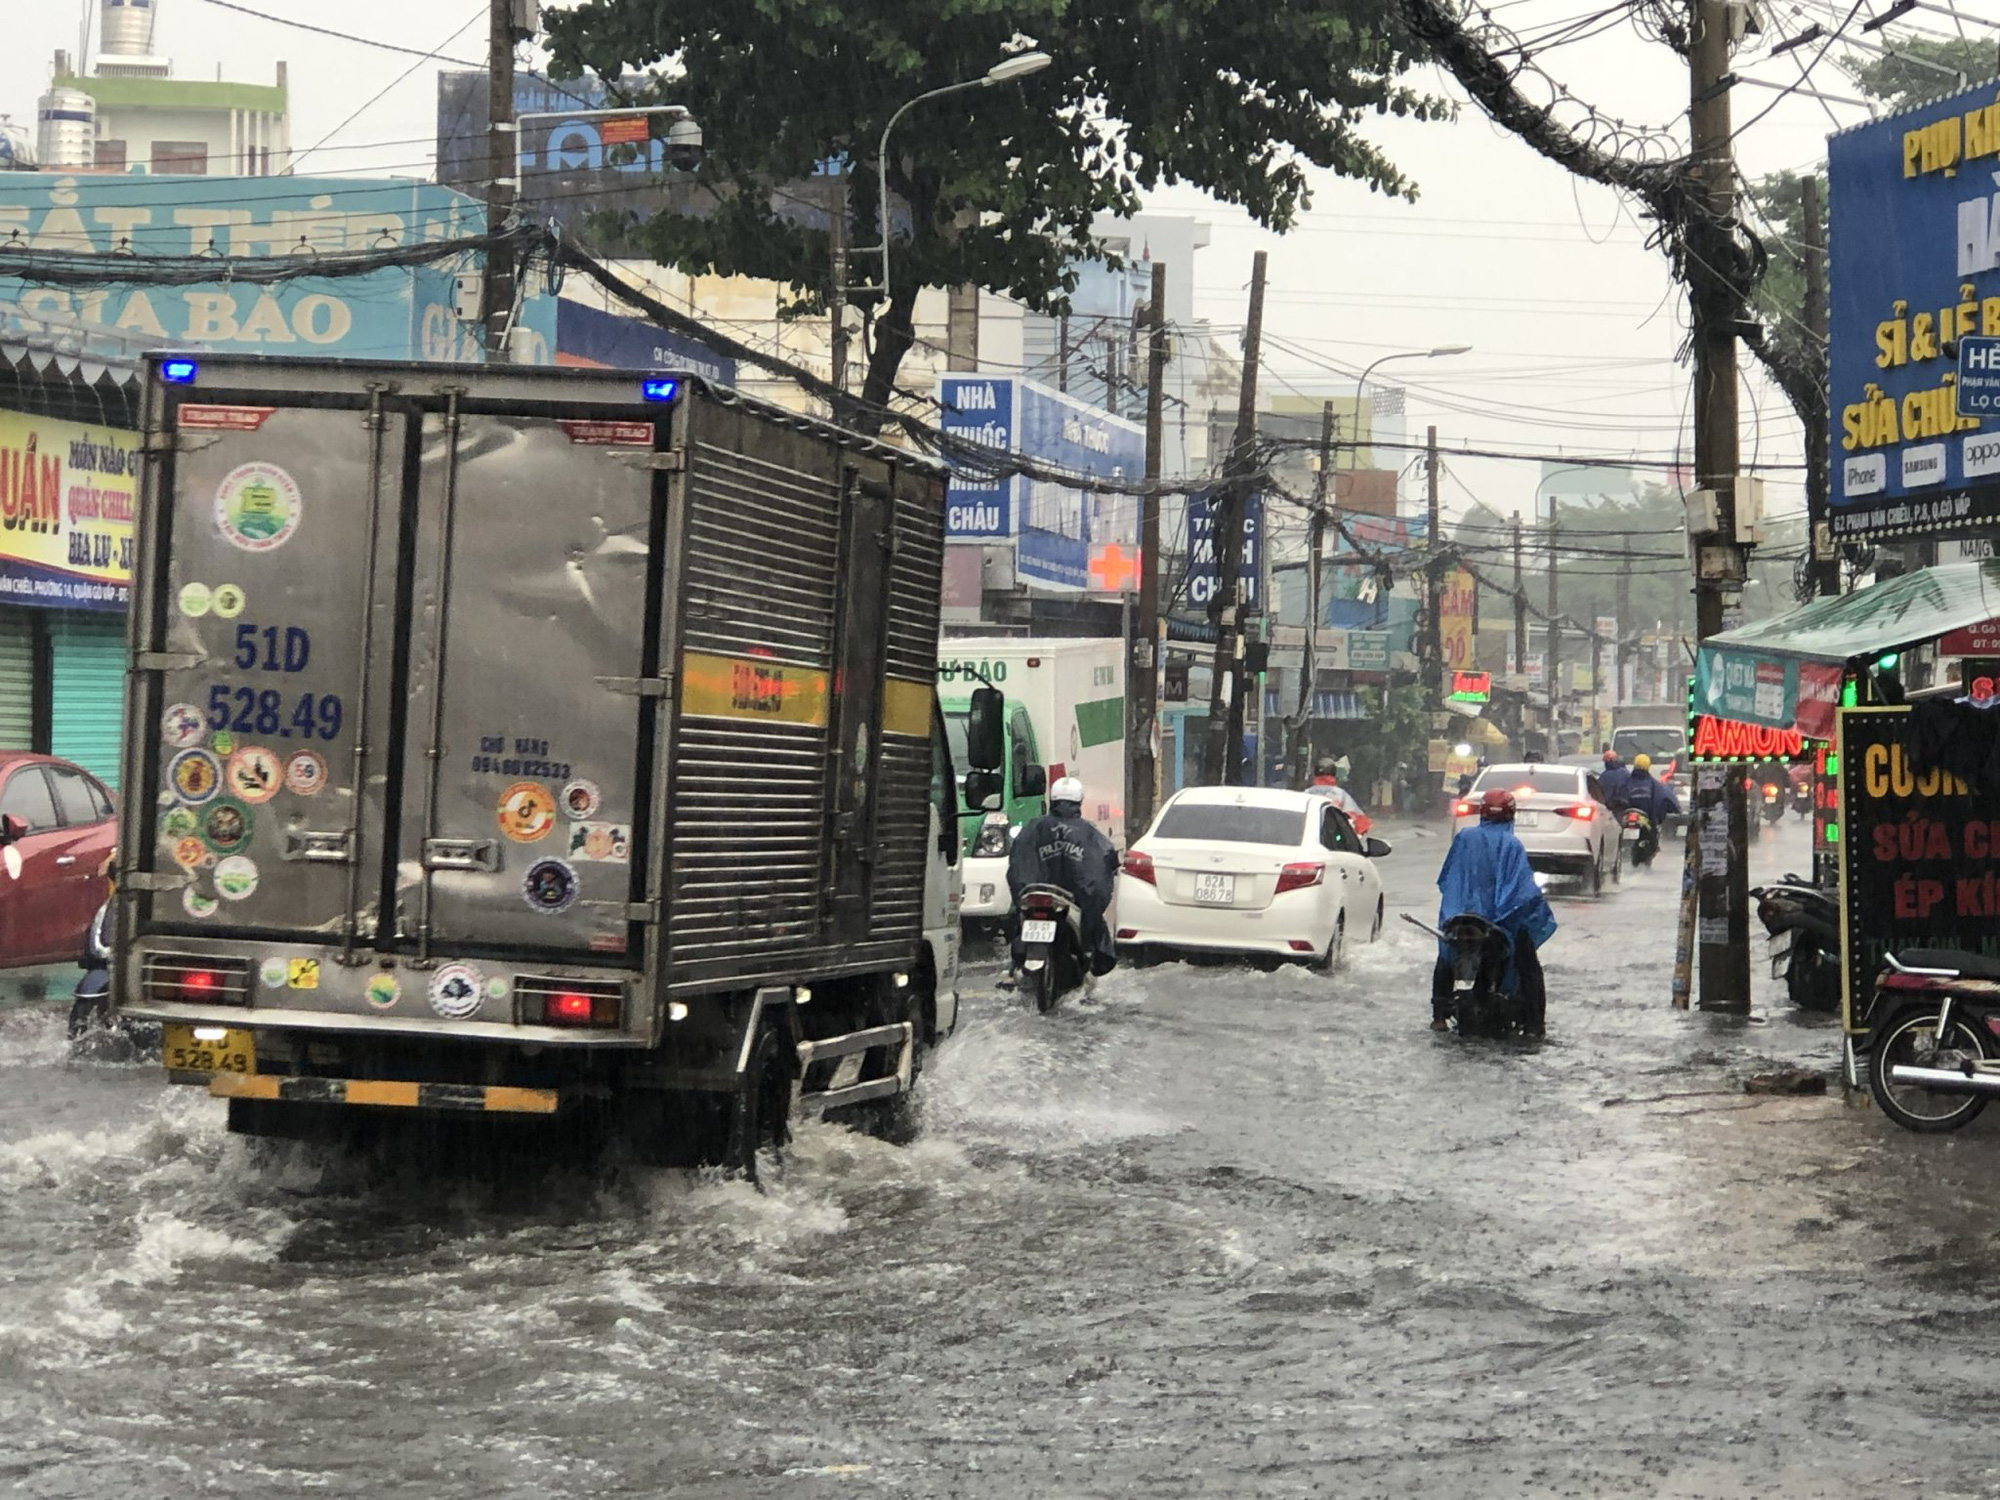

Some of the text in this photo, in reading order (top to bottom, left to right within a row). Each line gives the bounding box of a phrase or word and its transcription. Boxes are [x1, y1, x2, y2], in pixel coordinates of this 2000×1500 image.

[1904, 117, 1961, 179] PHỤ
[1911, 312, 1937, 361] &
[956, 382, 996, 410] NHÀ
[1842, 382, 1899, 451] SỬA
[1904, 456, 1938, 475] SAMSUNG
[949, 501, 1000, 531] CHÂU
[235, 624, 311, 673] 51D
[207, 685, 343, 740] 528.49
[1205, 876, 1225, 888] 62A
[1893, 872, 1944, 919] ÉP
